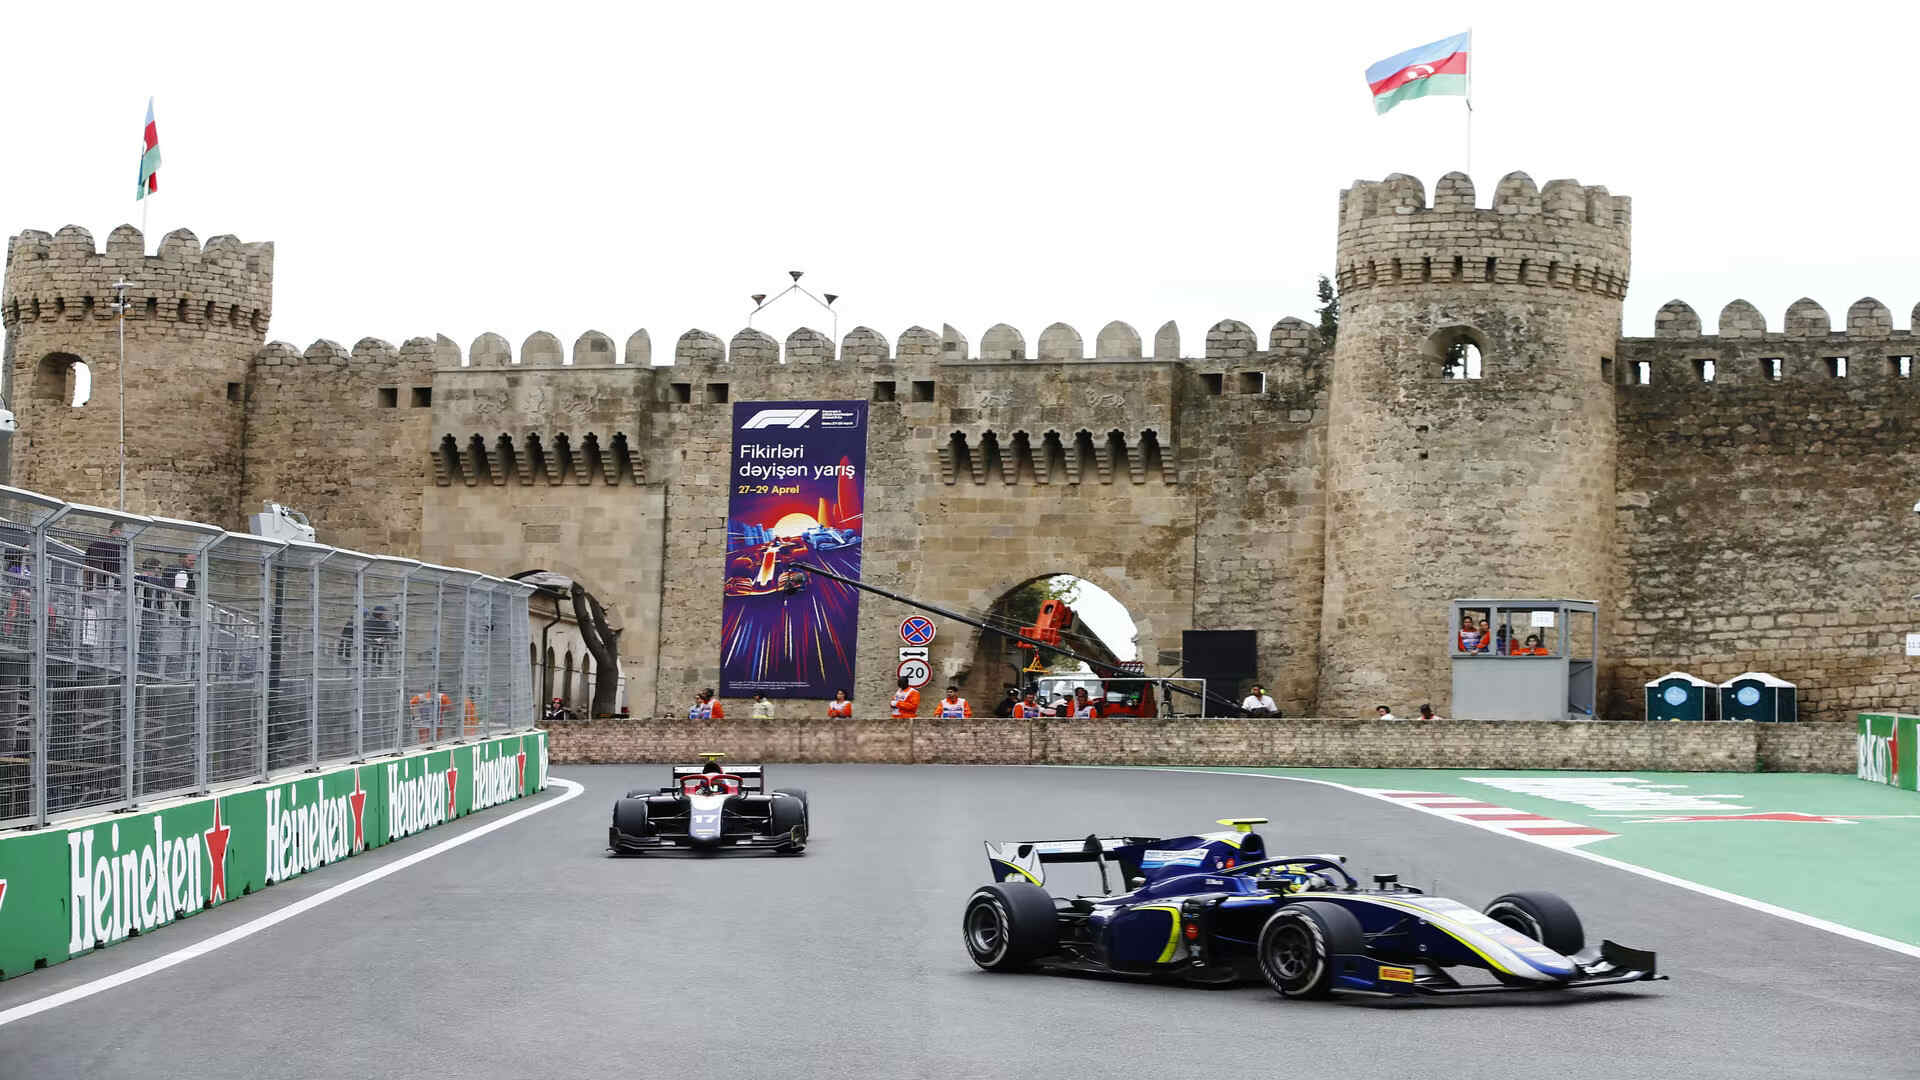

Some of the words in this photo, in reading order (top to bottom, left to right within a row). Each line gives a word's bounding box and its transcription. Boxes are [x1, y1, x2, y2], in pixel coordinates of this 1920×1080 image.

[739, 462, 808, 480] dəyişən
[814, 465, 856, 480] yarış
[740, 443, 804, 459] Fikirləri
[906, 667, 923, 679] 20
[388, 757, 445, 838] Heineken
[472, 742, 516, 811] Heineken
[265, 778, 349, 882] Heineken
[693, 814, 716, 824] 17
[68, 815, 203, 954] Heineken
